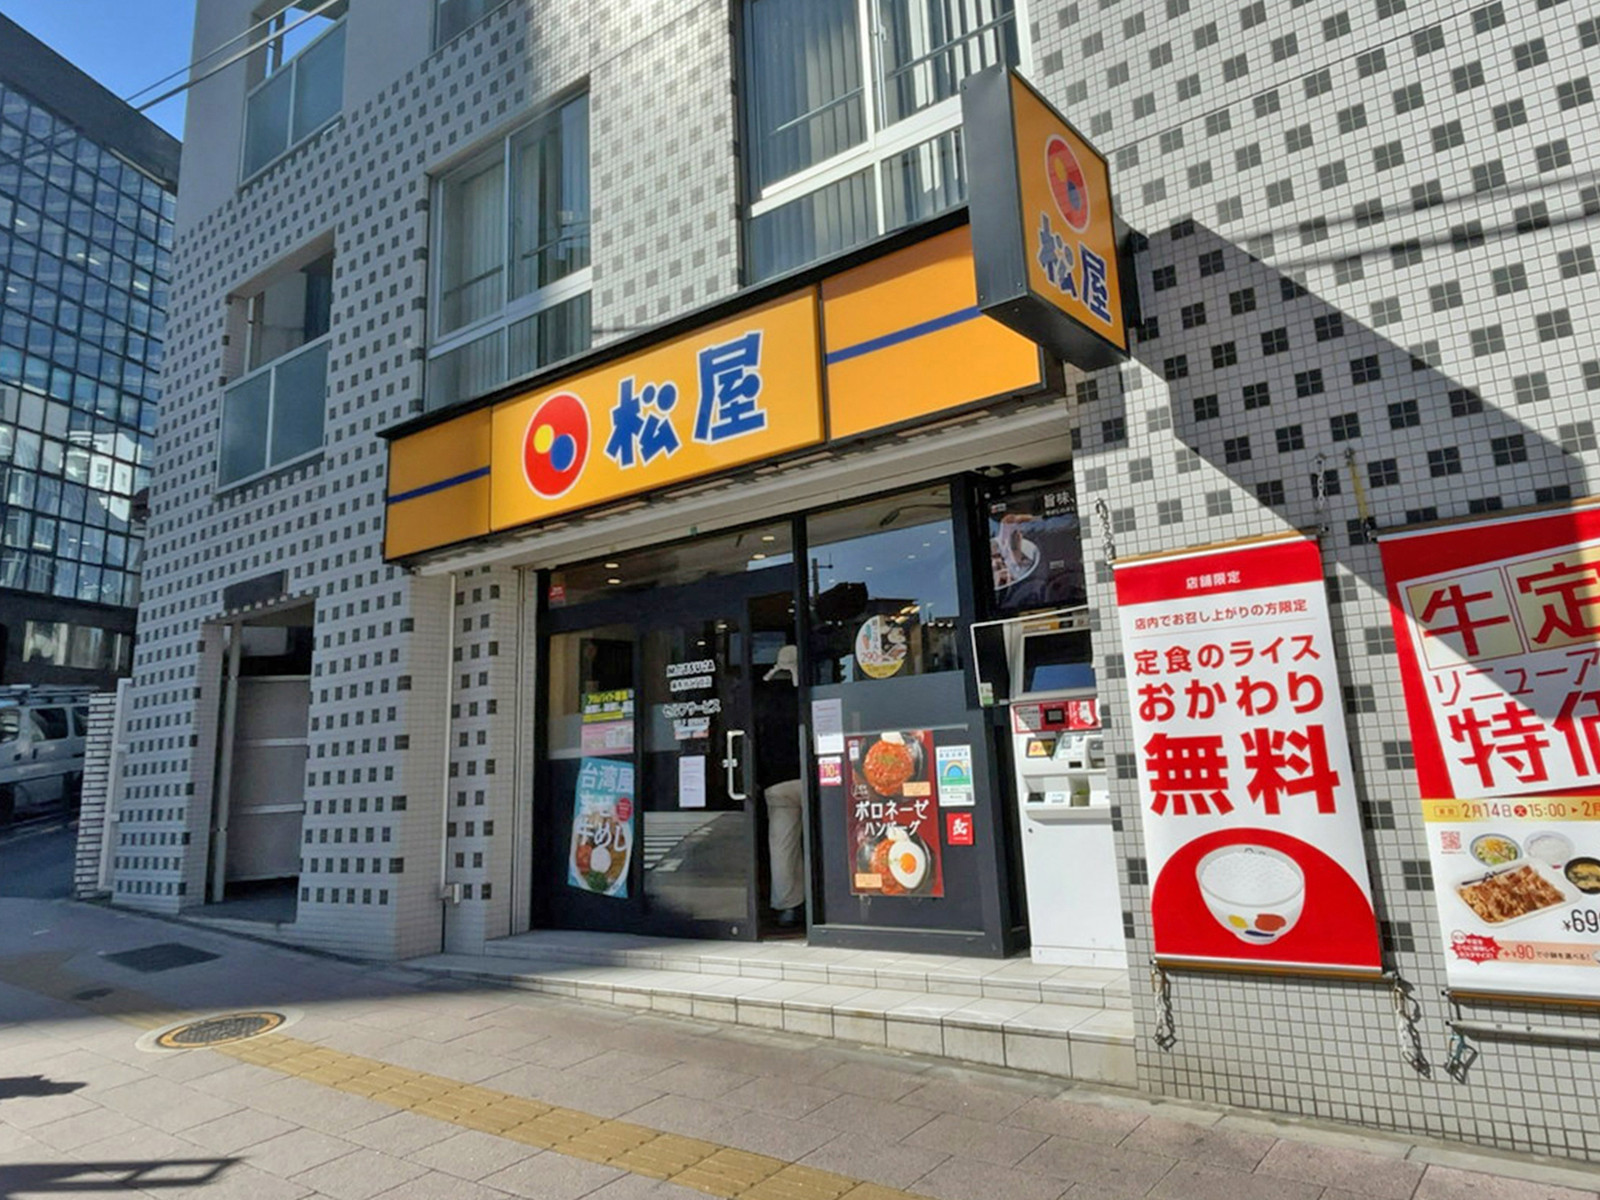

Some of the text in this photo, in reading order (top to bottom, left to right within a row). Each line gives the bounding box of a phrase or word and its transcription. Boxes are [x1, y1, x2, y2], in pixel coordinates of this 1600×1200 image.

[1037, 211, 1113, 326] 松屋
[603, 329, 767, 470] 松屋
[1186, 570, 1241, 589] 店舗限定
[1134, 599, 1308, 630] 店内でお召し上がりの方限定
[1420, 561, 1600, 657] 牛定
[1134, 635, 1320, 676] 定食のライス
[1433, 648, 1600, 708] リニューア
[1137, 671, 1324, 722] おかわり
[1143, 724, 1341, 816] 無料
[855, 799, 929, 821] ボロネーゼ
[1563, 908, 1600, 933] ¥69
